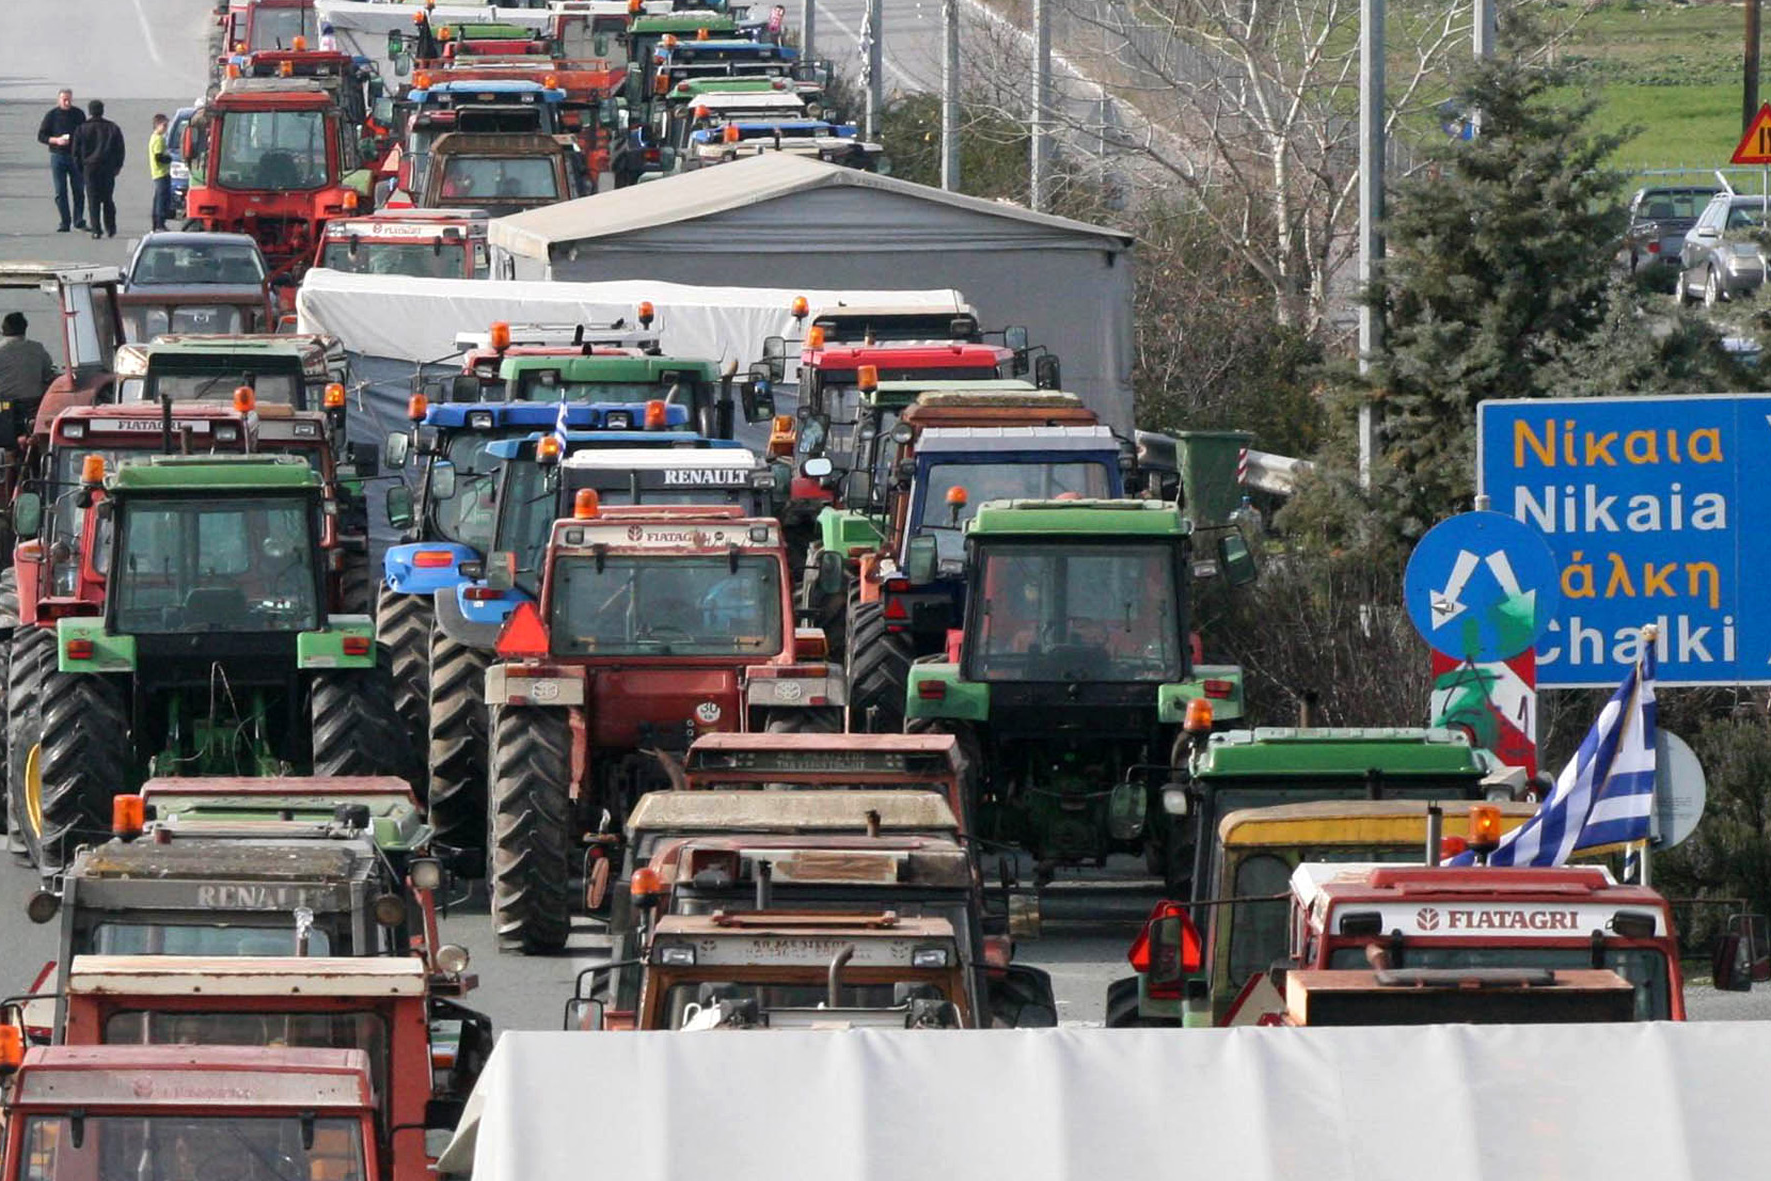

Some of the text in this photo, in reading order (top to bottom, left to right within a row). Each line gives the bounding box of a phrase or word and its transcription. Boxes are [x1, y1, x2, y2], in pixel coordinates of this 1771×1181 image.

[1514, 418, 1724, 468] Νίκαια
[664, 469, 748, 484] RENAULT
[1514, 482, 1726, 534] Nikaia
[646, 532, 708, 543] FIATAG
[1448, 910, 1579, 930] FIATAGRI
